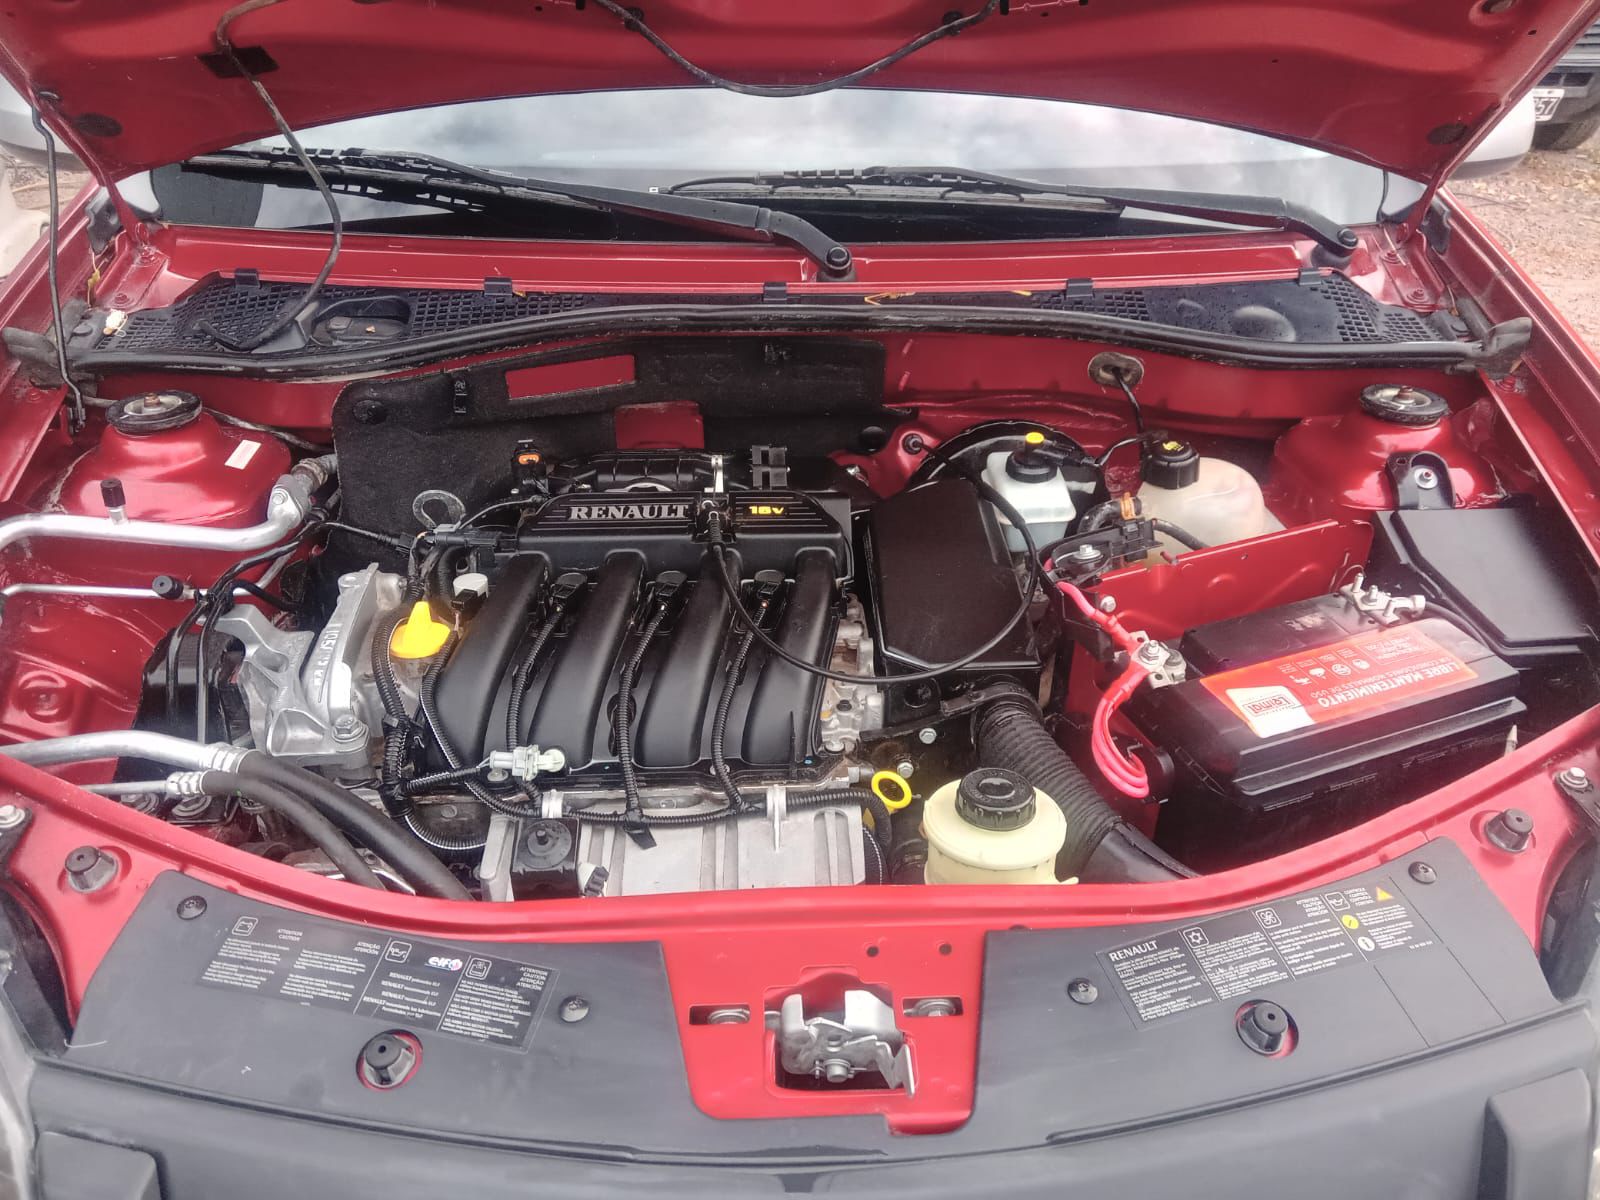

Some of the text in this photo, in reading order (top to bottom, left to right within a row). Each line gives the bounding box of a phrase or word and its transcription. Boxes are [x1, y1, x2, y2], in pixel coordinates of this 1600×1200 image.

[1533, 98, 1558, 115] 57
[569, 504, 689, 520] RENAULT
[1311, 689, 1327, 698] USO
[1317, 662, 1460, 708] LIBRE MANTENIMIENTO
[1109, 940, 1158, 962] RENAULT
